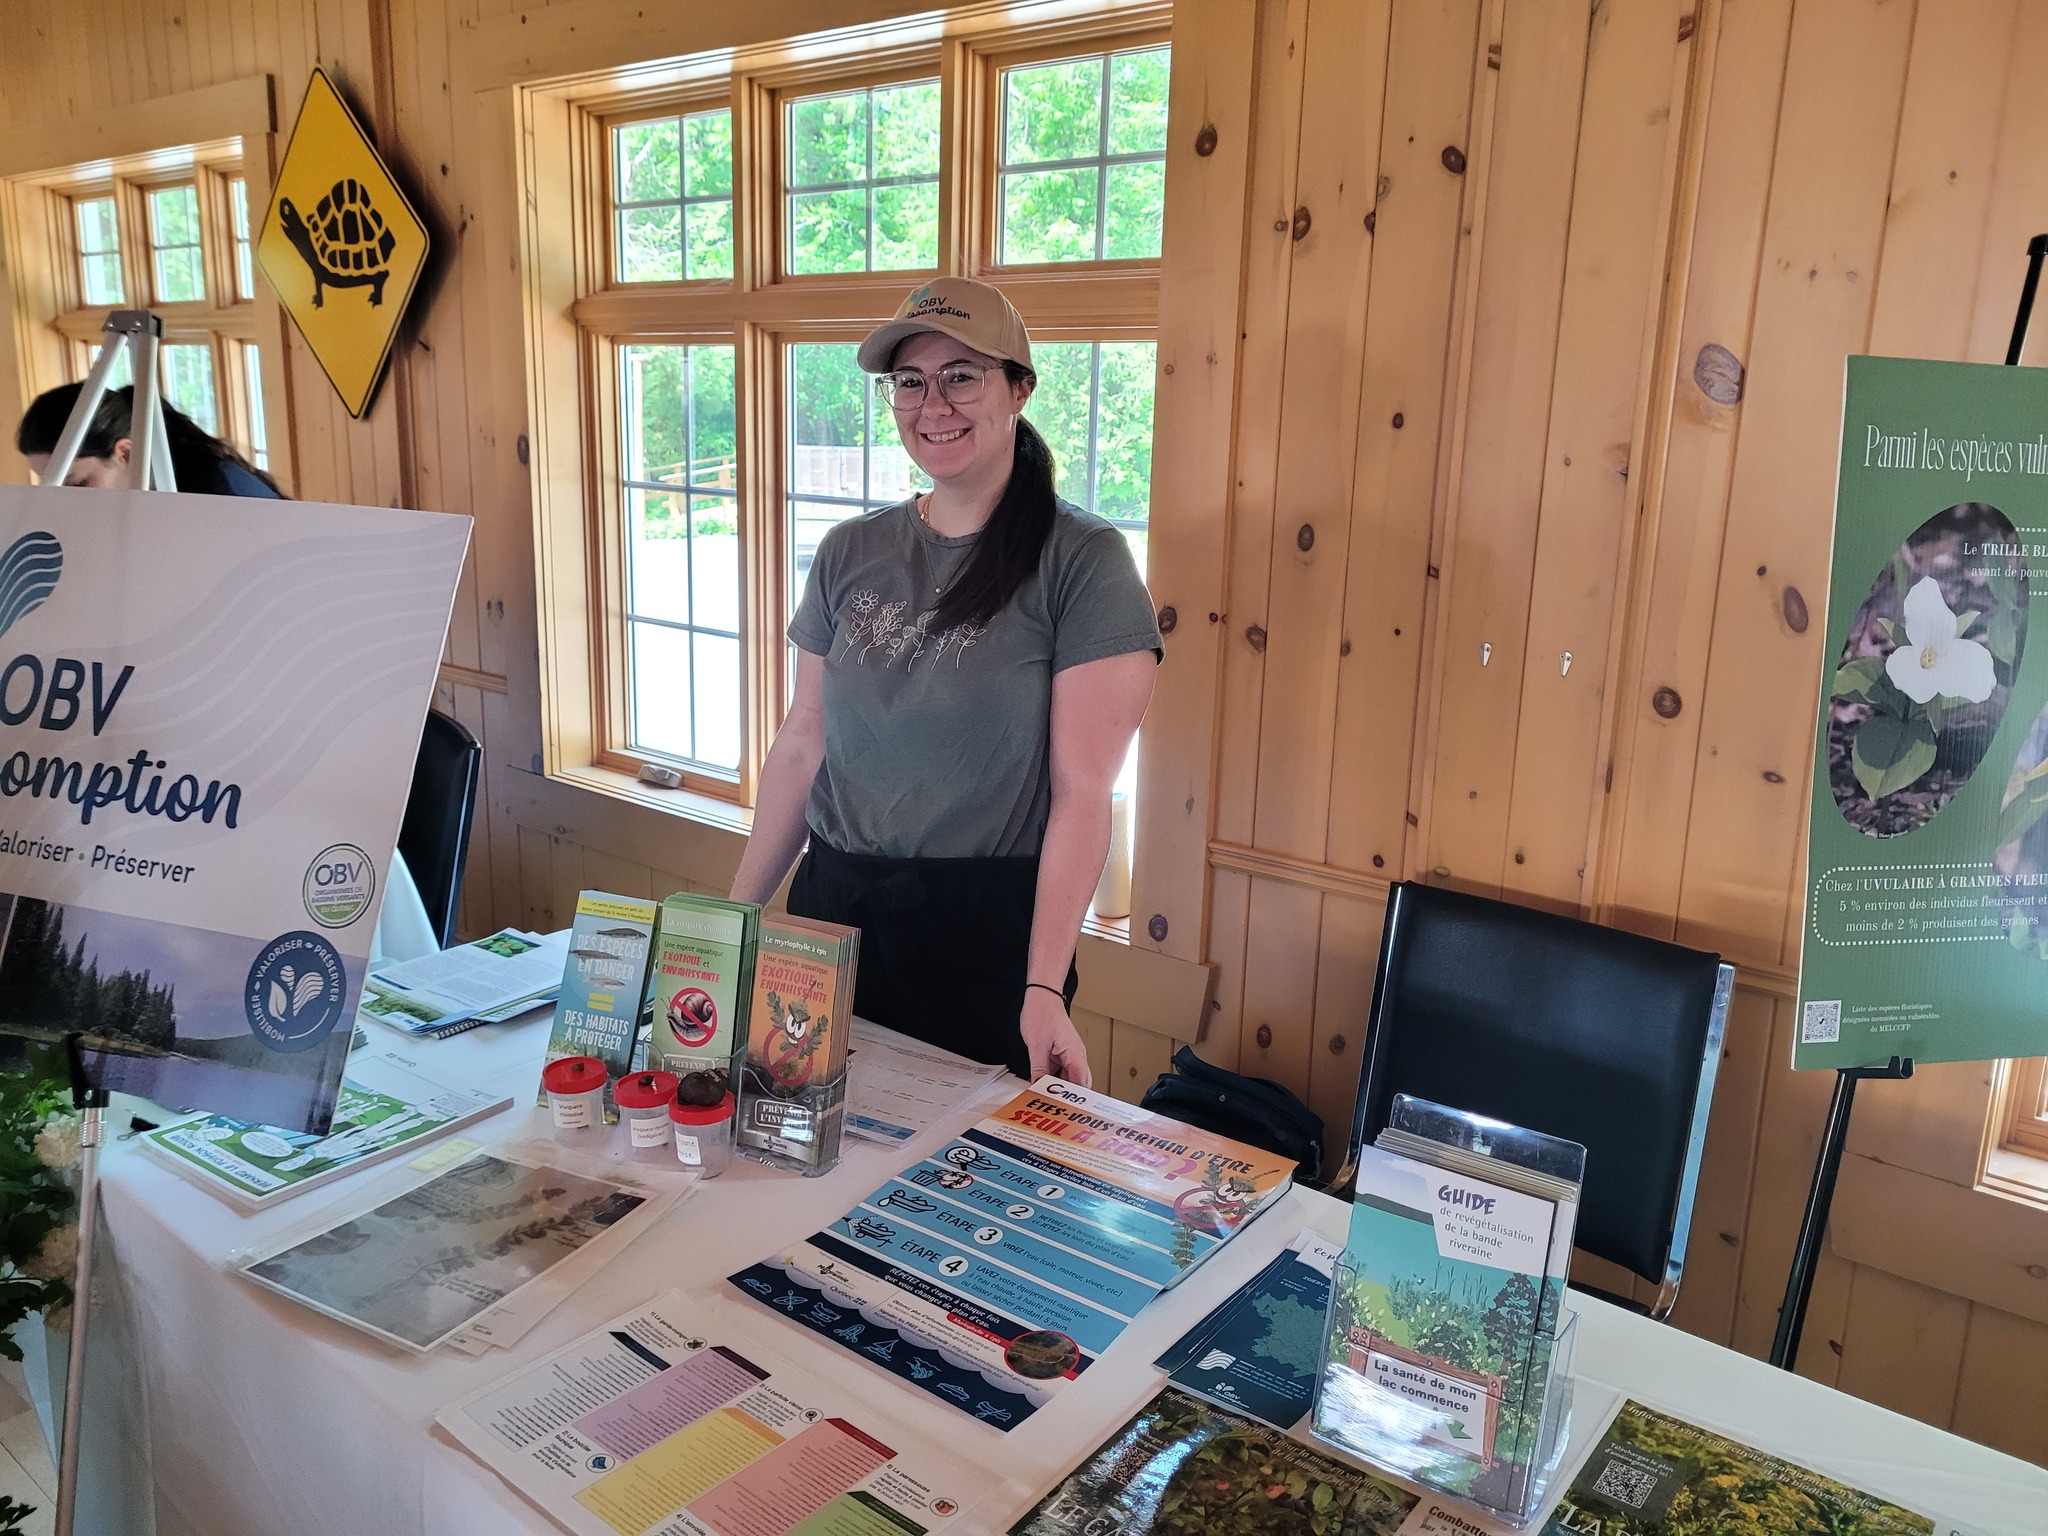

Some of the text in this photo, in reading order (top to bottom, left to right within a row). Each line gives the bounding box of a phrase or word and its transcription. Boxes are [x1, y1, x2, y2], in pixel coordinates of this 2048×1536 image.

[919, 297, 947, 308] OBV
[1864, 425, 1917, 468] Parmi
[1921, 428, 1945, 470] les
[1950, 434, 2012, 482] espèces
[1963, 543, 2048, 557] Le TRILLE BL
[1971, 567, 2001, 577] avant
[2004, 565, 2017, 577] de
[0, 654, 136, 736] OBV
[0, 750, 242, 829] omption
[91, 845, 195, 883] Préserver
[314, 862, 364, 886] OBV
[314, 887, 353, 896] ORGANISMES
[1825, 879, 1852, 892] Chez
[1856, 876, 1934, 891] l'UVULAIRE
[1937, 873, 1946, 889] À
[1950, 874, 2012, 888] GRANDES
[1839, 895, 2035, 912] 5 % environ des individus fleurissent
[666, 916, 732, 935] La vivipare chinoise
[1846, 915, 2039, 932] moins de 2 % produisent des graines
[577, 934, 597, 949] DES
[664, 941, 724, 958] Une espèce aquatique
[765, 935, 827, 956] Le myriophylle épis
[256, 939, 303, 979] VALORISER
[578, 958, 635, 981] EN DANGER
[661, 964, 721, 983] ENVAHISSANTE
[662, 950, 702, 966] EXOTIQUE
[763, 953, 829, 976] Une espèce aquatique
[313, 945, 339, 1003] PRÉSERVER
[761, 964, 824, 990] EXOTIQUE et
[760, 979, 828, 1005] ENVAHISSANTE
[252, 995, 285, 1043] MOBILISER
[564, 1010, 630, 1036] DES HABITATS
[558, 1103, 584, 1111] Vivipare
[559, 1110, 584, 1118] chinoise
[1009, 1108, 1070, 1137] SEUL
[1070, 1130, 1096, 1144] À
[1025, 1097, 1255, 1175] ÊTES-VOUS CERTAIN D'ÊTRE
[1000, 1169, 1058, 1198] ÉTAPE 1
[1026, 1152, 1148, 1205] Freinez introduction appliquant
[1039, 1163, 1060, 1175] étapes
[1060, 1170, 1081, 1184] faciles
[1126, 1197, 1147, 1209] d'eau
[967, 1188, 1029, 1218] ÉTAPE 2
[1437, 1183, 1496, 1215] GUIDE
[935, 1210, 998, 1241] ÉTAPE 3
[1038, 1212, 1096, 1241] RETIREZ boues
[1039, 1219, 1130, 1261] JETEZ-les plan d'eau
[1439, 1206, 1534, 1244] de revégétalisation
[1444, 1221, 1503, 1249] de la bande
[899, 1239, 964, 1273] ÉTAPE 4
[1449, 1238, 1493, 1260] riveraine
[1002, 1241, 1124, 1298] VIDEZ l'eau (cale, moteur, vivier, etc.)
[829, 1285, 855, 1300] Québec
[889, 1265, 919, 1286] RÉPÉTEZ
[930, 1286, 954, 1303] étapes
[960, 1299, 986, 1319] chaque
[985, 1312, 1001, 1325] fois
[898, 1281, 991, 1330] vous changez plan d'eau.
[970, 1280, 1069, 1333] laissez sécher pendant jours
[974, 1272, 1073, 1325] l'eau chaude, haute pression
[975, 1264, 1089, 1321] LAVEZ votre équipement nautique
[1374, 1359, 1477, 1401] La santé de mon
[1378, 1375, 1469, 1413] lac commence
[1164, 1391, 1207, 1415] Influencez
[1207, 1408, 1231, 1426] votre
[1230, 1418, 1277, 1443] collectivité
[1276, 1437, 1299, 1455] pour
[1310, 1454, 1332, 1469] mise
[1628, 1405, 1683, 1434] Influencez
[1679, 1426, 1707, 1442] votre
[1707, 1436, 1764, 1463] collectivité
[1763, 1457, 1791, 1474] pour
[1604, 1447, 1659, 1475] d'aménagement
[1609, 1442, 1674, 1474] Téléchargez plan
[1043, 1492, 1089, 1526] LE
[1558, 1504, 1601, 1536] LA
